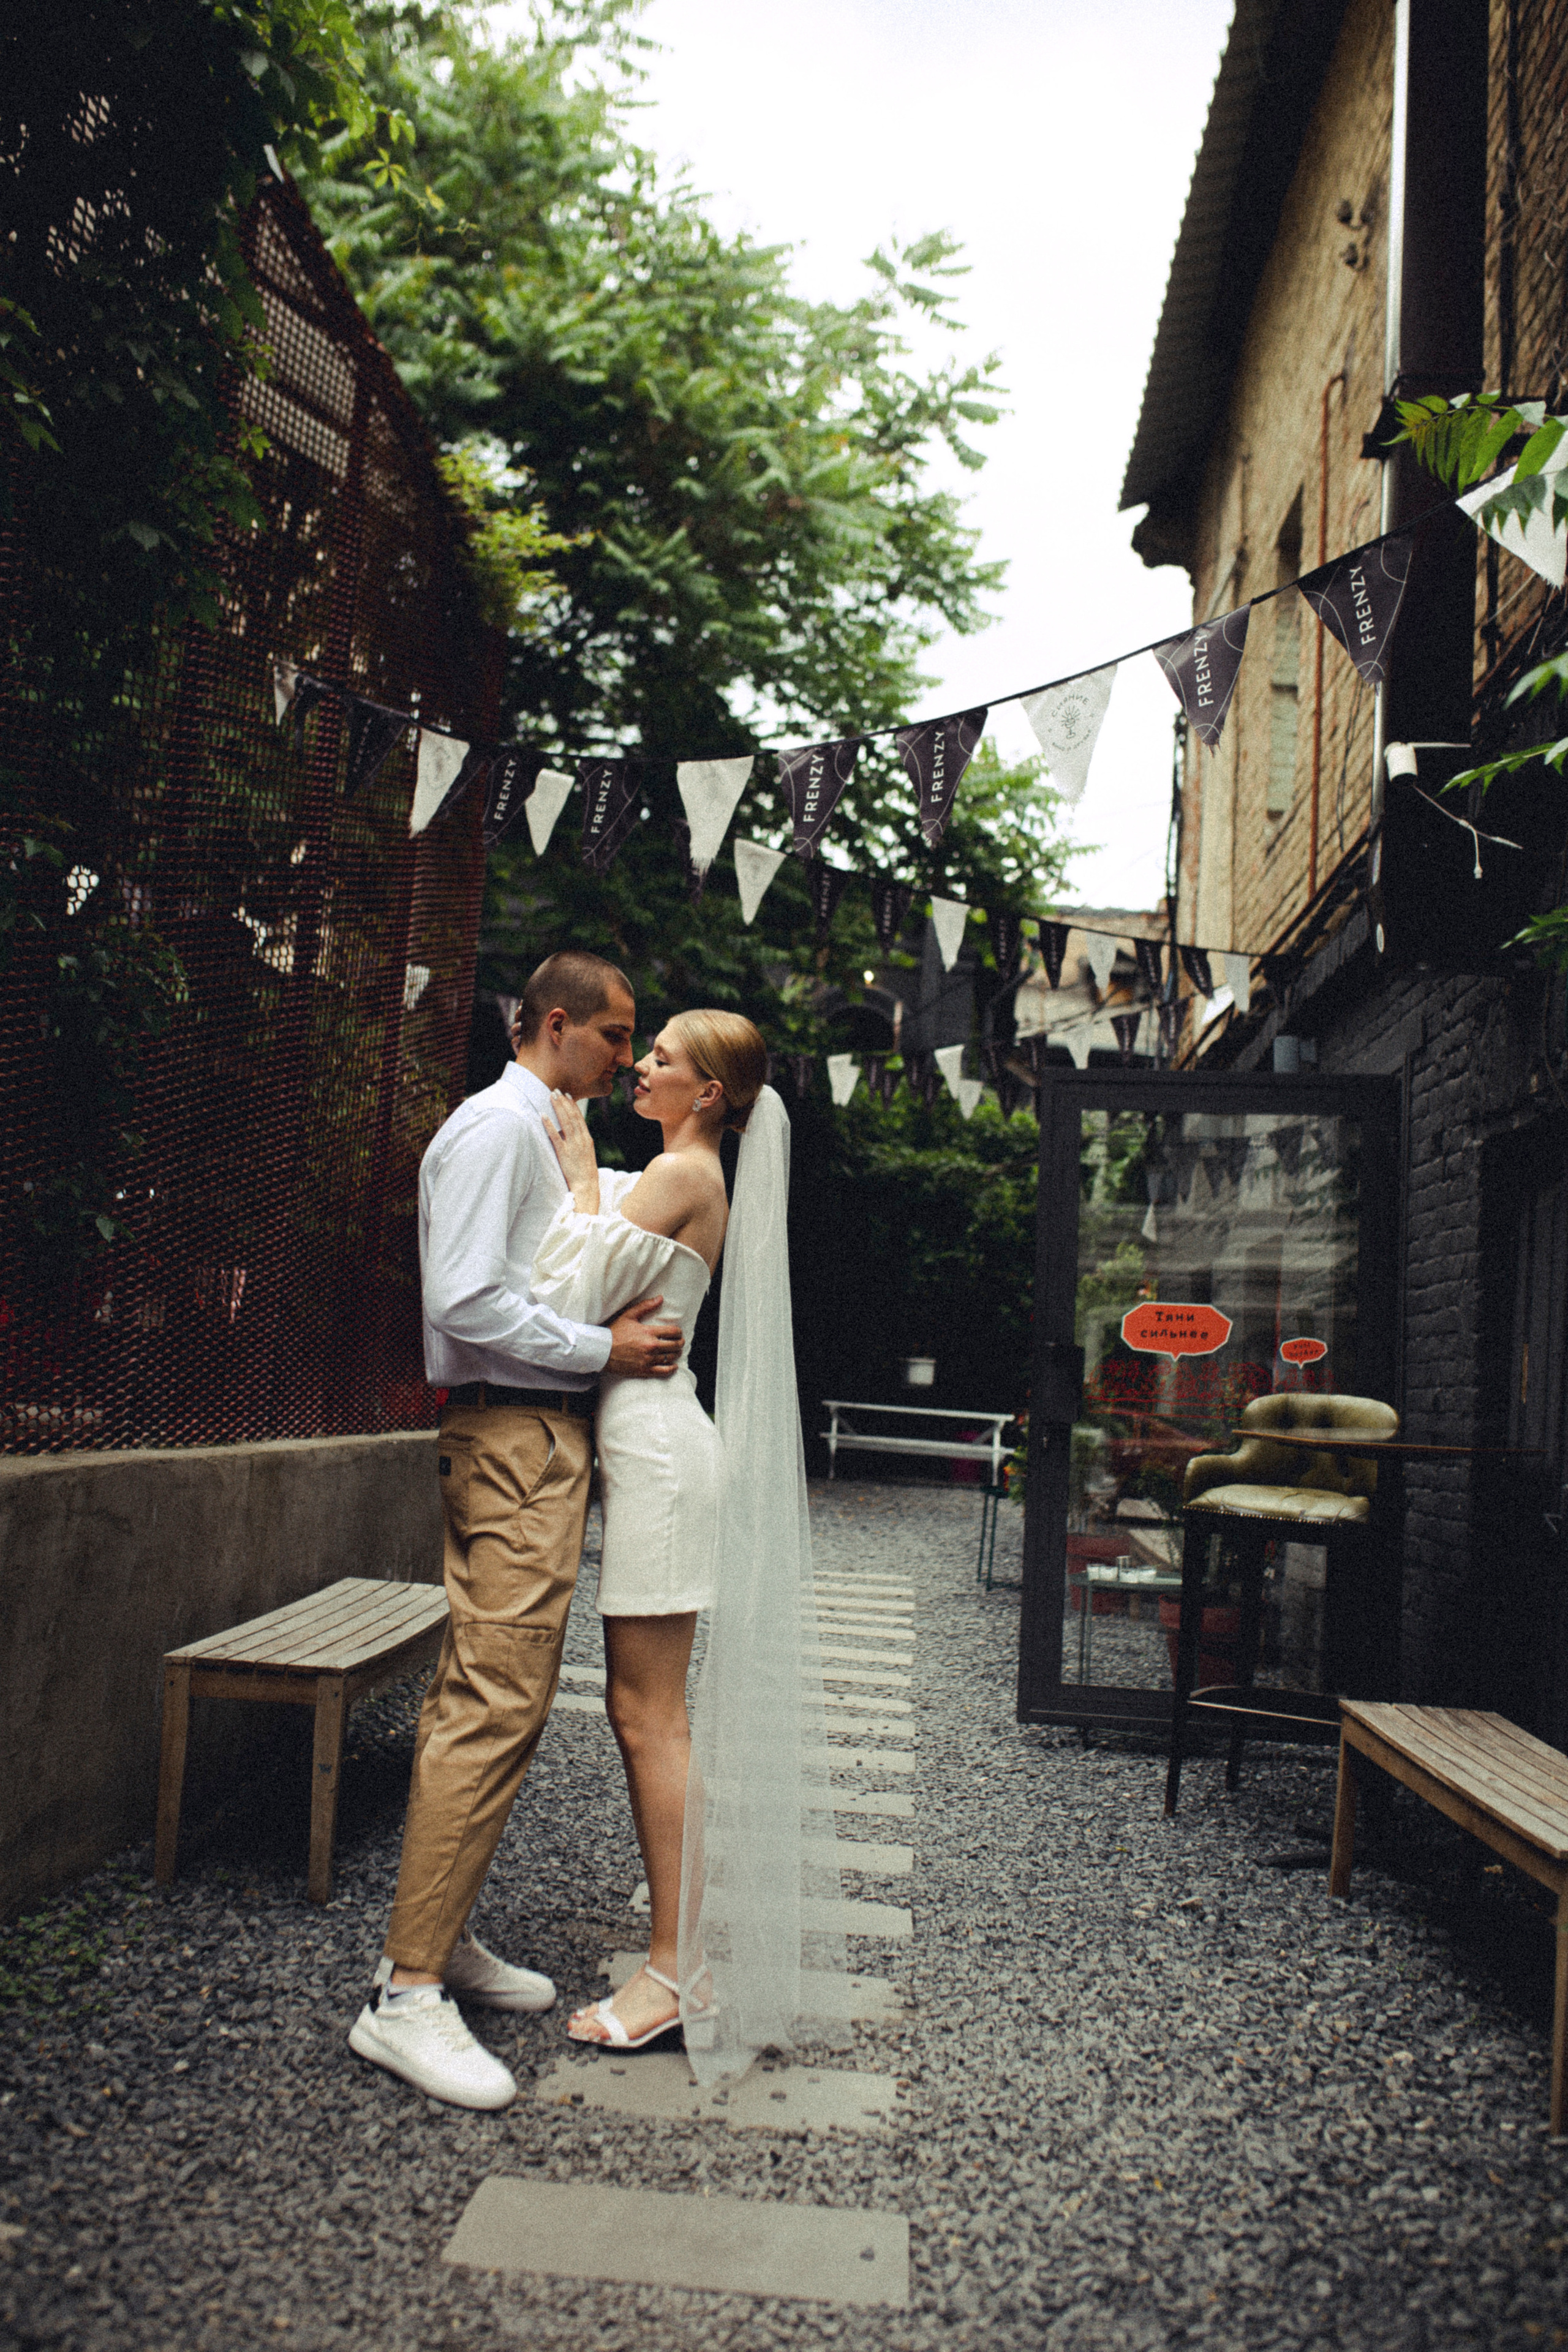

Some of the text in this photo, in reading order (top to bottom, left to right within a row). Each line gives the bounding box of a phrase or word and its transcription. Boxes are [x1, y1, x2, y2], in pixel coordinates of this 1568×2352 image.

[1349, 565, 1377, 646] FRENZY
[1194, 634, 1215, 707] FRENZY
[494, 759, 517, 821] FRENZY
[803, 753, 825, 823] FRENZY
[931, 731, 946, 803] FRENZY
[590, 769, 613, 834] FRENZY
[1140, 1329, 1208, 1340] сильнее
[1155, 1311, 1195, 1322] Тяни
